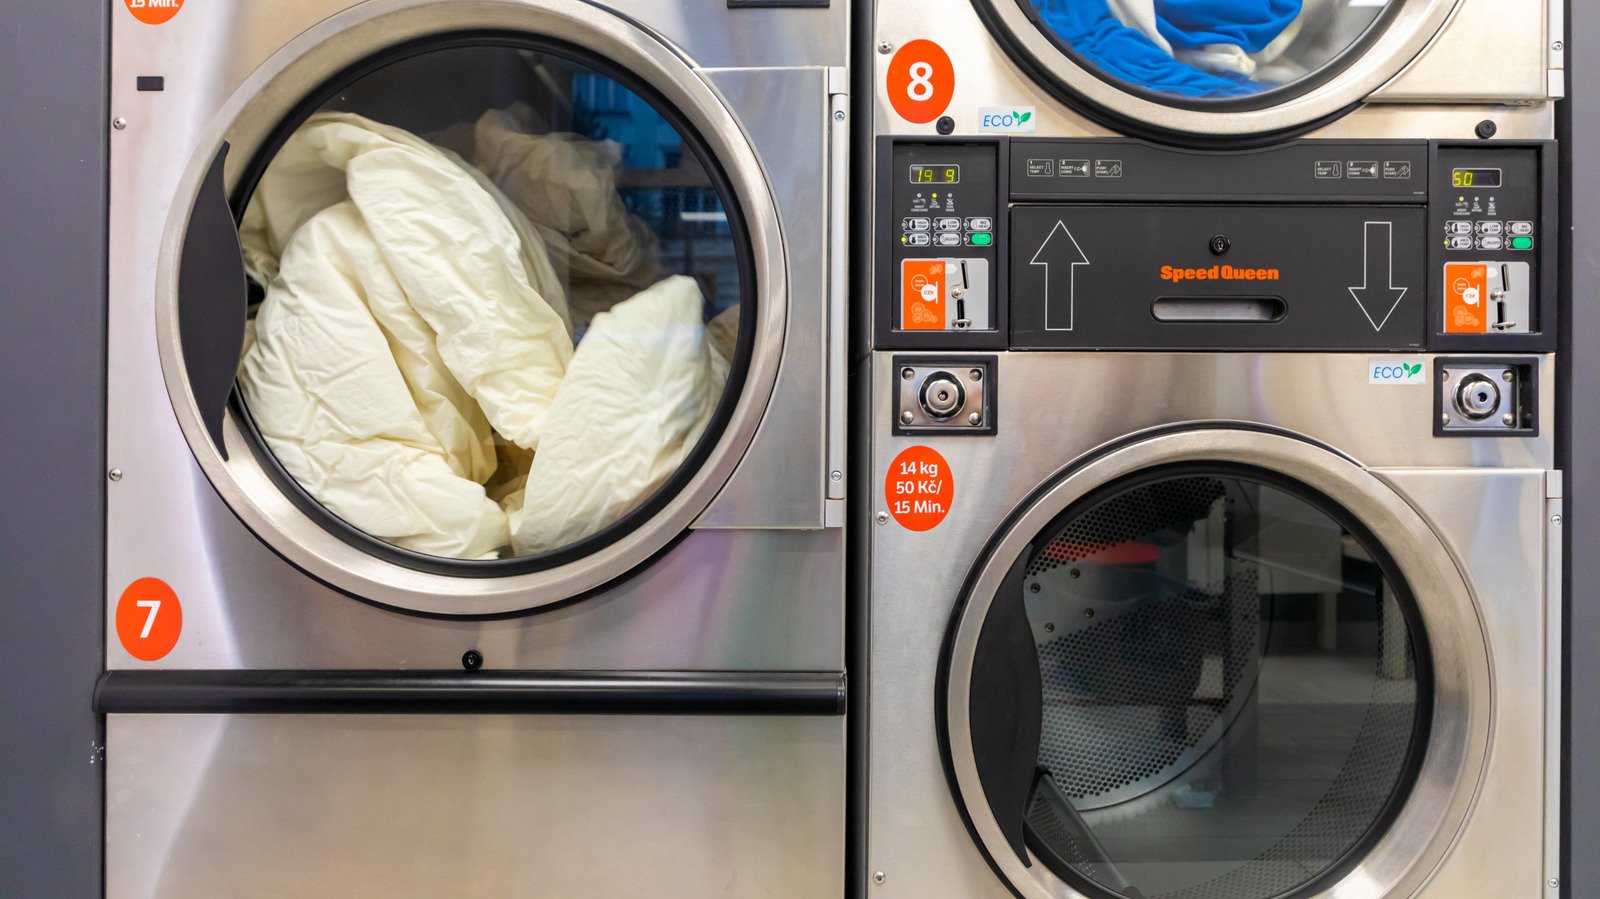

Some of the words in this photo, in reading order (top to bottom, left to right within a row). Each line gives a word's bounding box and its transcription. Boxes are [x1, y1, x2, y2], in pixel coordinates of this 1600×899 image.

[906, 61, 934, 102] 8
[983, 114, 1013, 127] ECO
[1453, 172, 1473, 186] 50
[1160, 265, 1219, 282] Speed
[1220, 265, 1279, 280] Queen
[1373, 366, 1404, 379] ECO
[900, 461, 917, 475] 14
[920, 461, 938, 478] kg
[896, 480, 914, 494] 50
[918, 480, 942, 495] Kč/
[894, 501, 910, 514] 15
[914, 500, 945, 514] Min.
[136, 600, 161, 638] 7
